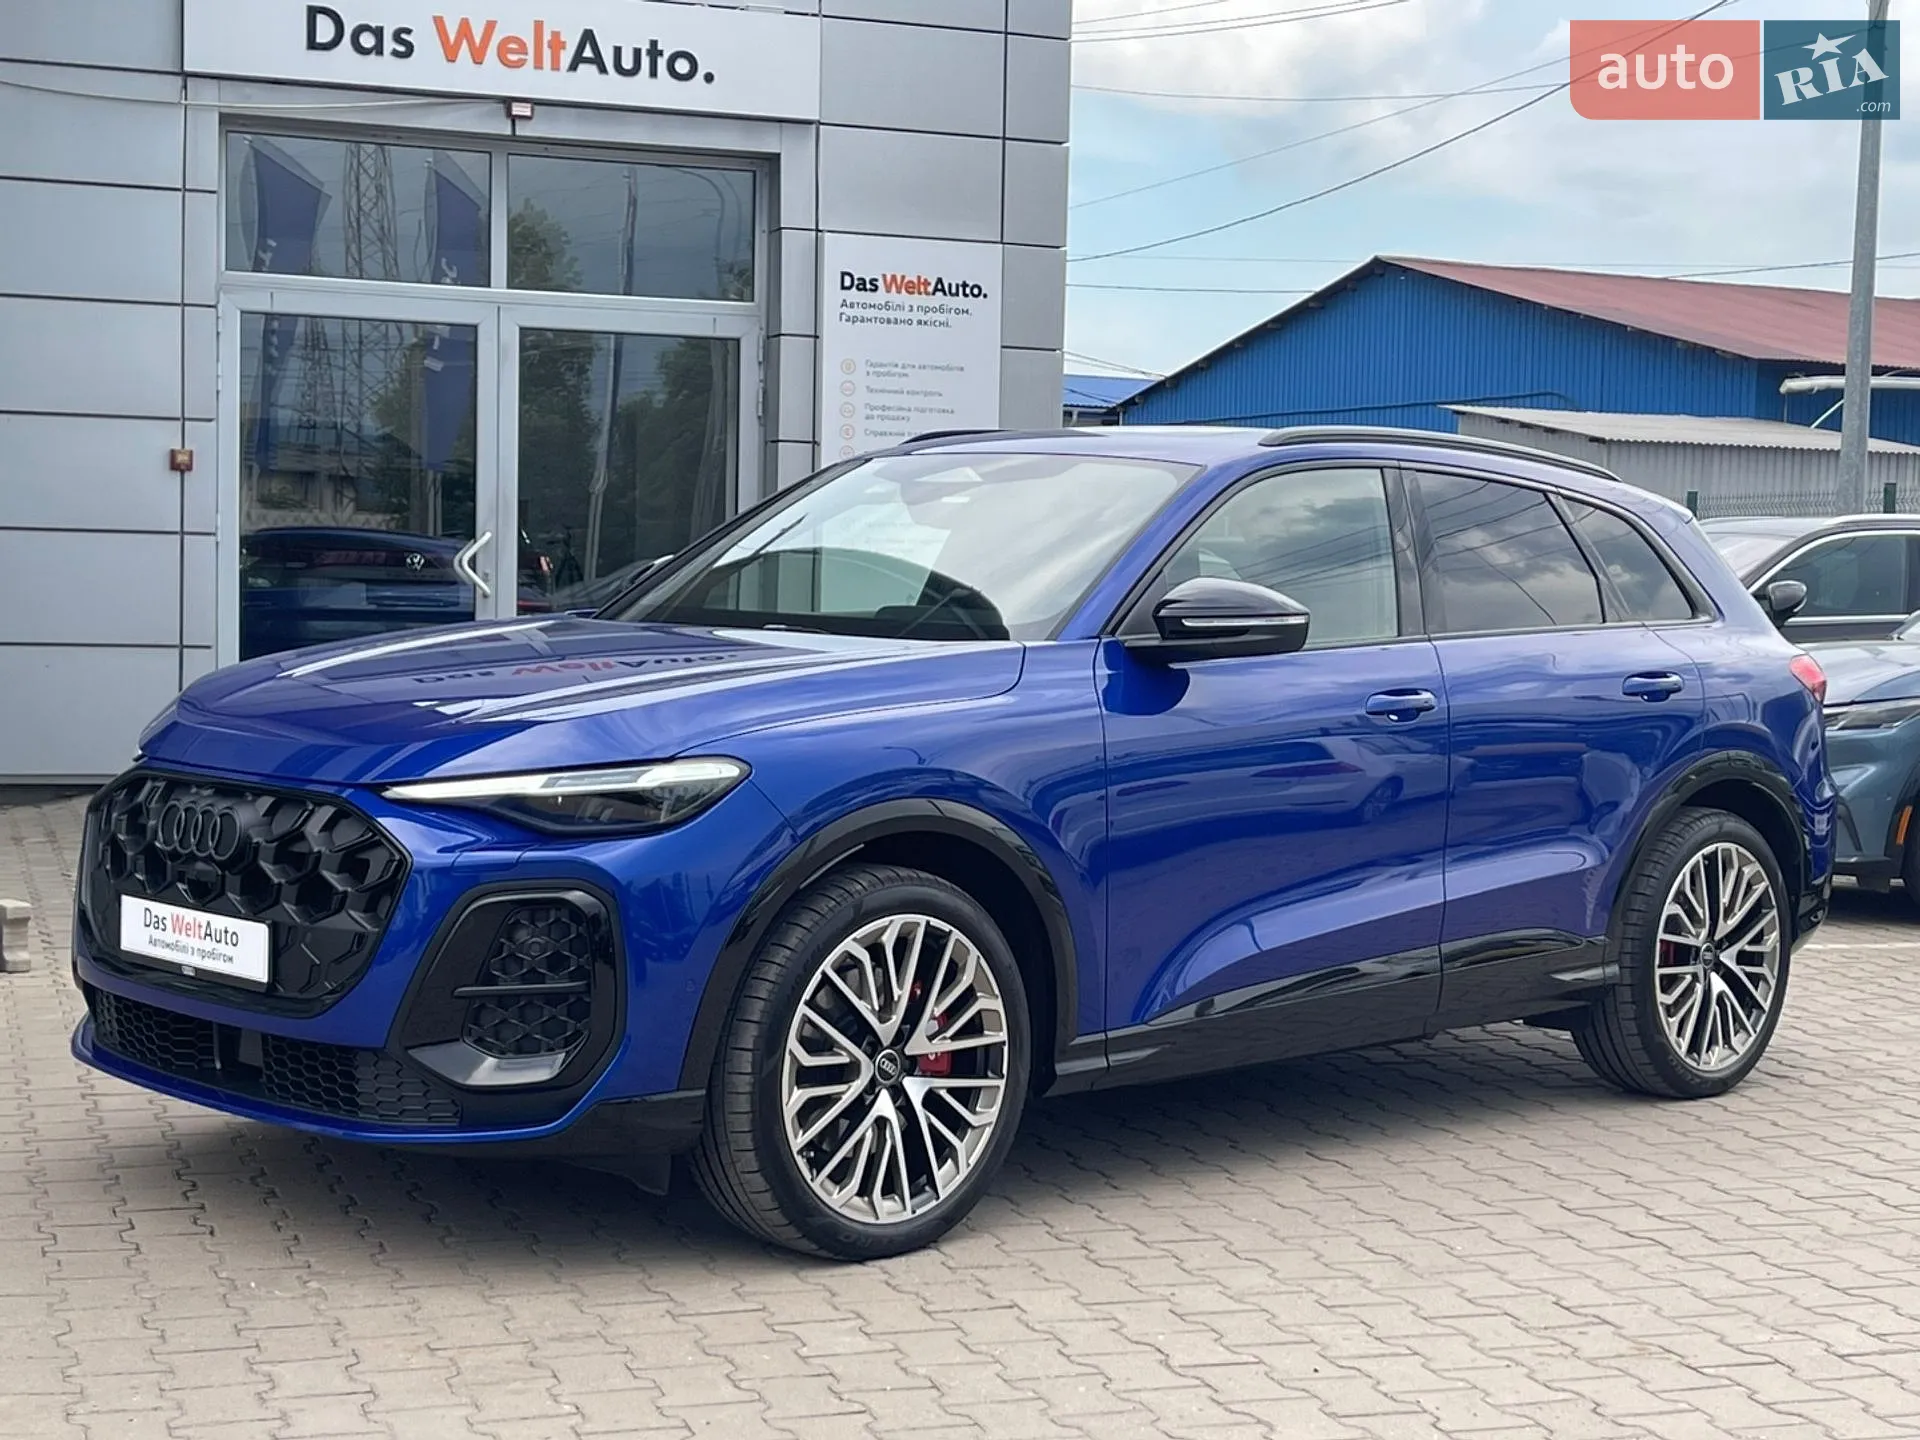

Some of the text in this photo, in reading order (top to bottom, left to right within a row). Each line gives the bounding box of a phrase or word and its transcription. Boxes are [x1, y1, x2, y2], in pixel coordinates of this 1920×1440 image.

[306, 4, 715, 84] Das WeltAuto.
[840, 270, 988, 299] Das WeltAuto.
[839, 312, 952, 328] Гарантовано якісні.
[840, 299, 972, 316] Автомобілі з пробігом.
[144, 907, 239, 947] Das WeltAuto
[148, 934, 235, 965] Автомобілі з пробігом
